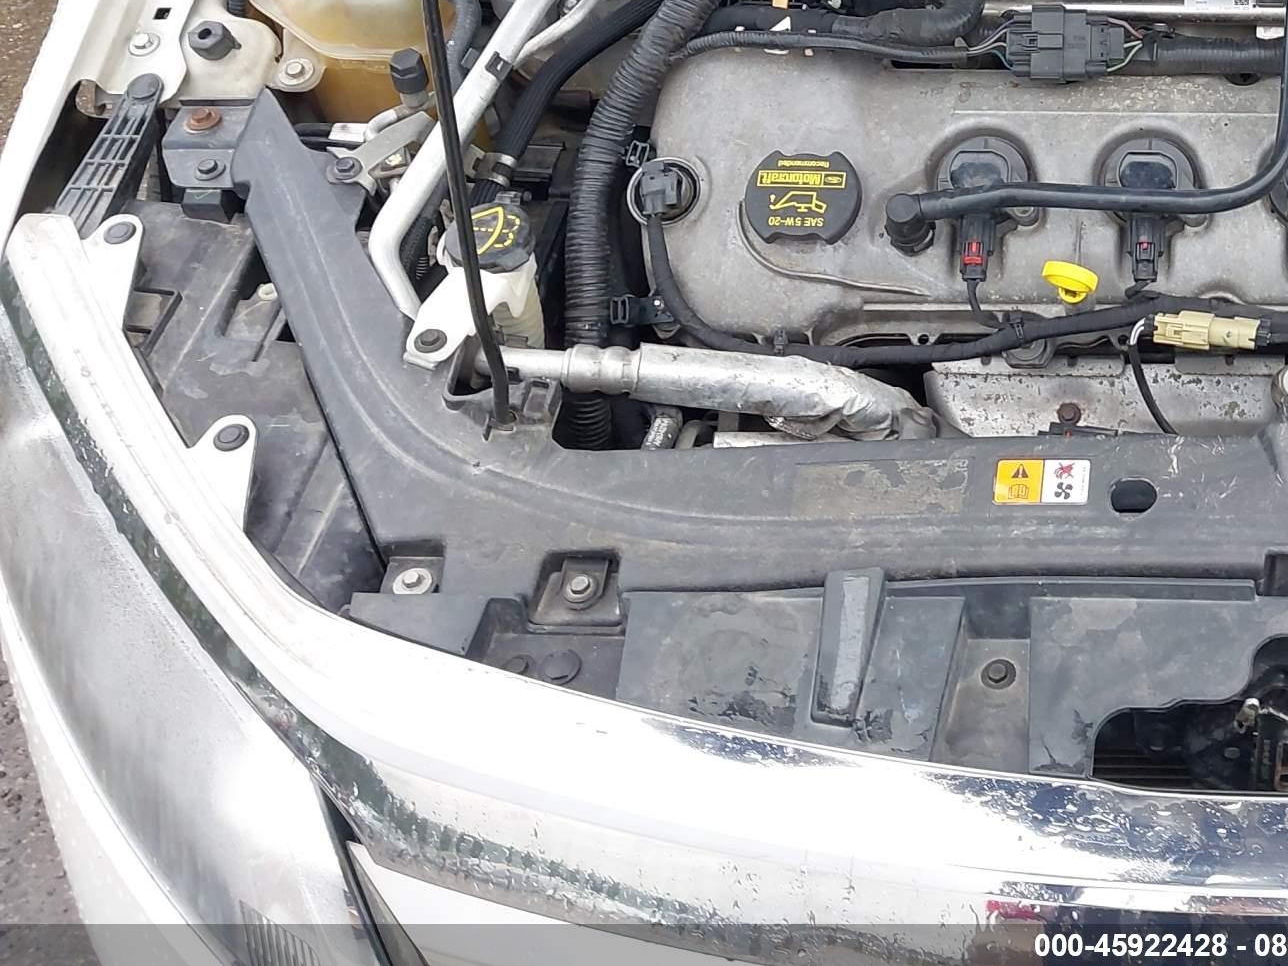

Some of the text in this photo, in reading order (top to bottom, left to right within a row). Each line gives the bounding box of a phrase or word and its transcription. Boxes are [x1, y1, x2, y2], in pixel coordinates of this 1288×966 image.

[778, 160, 830, 168] Recommended
[761, 173, 821, 186] Motorcraft
[768, 217, 824, 227] SAE 5W-20
